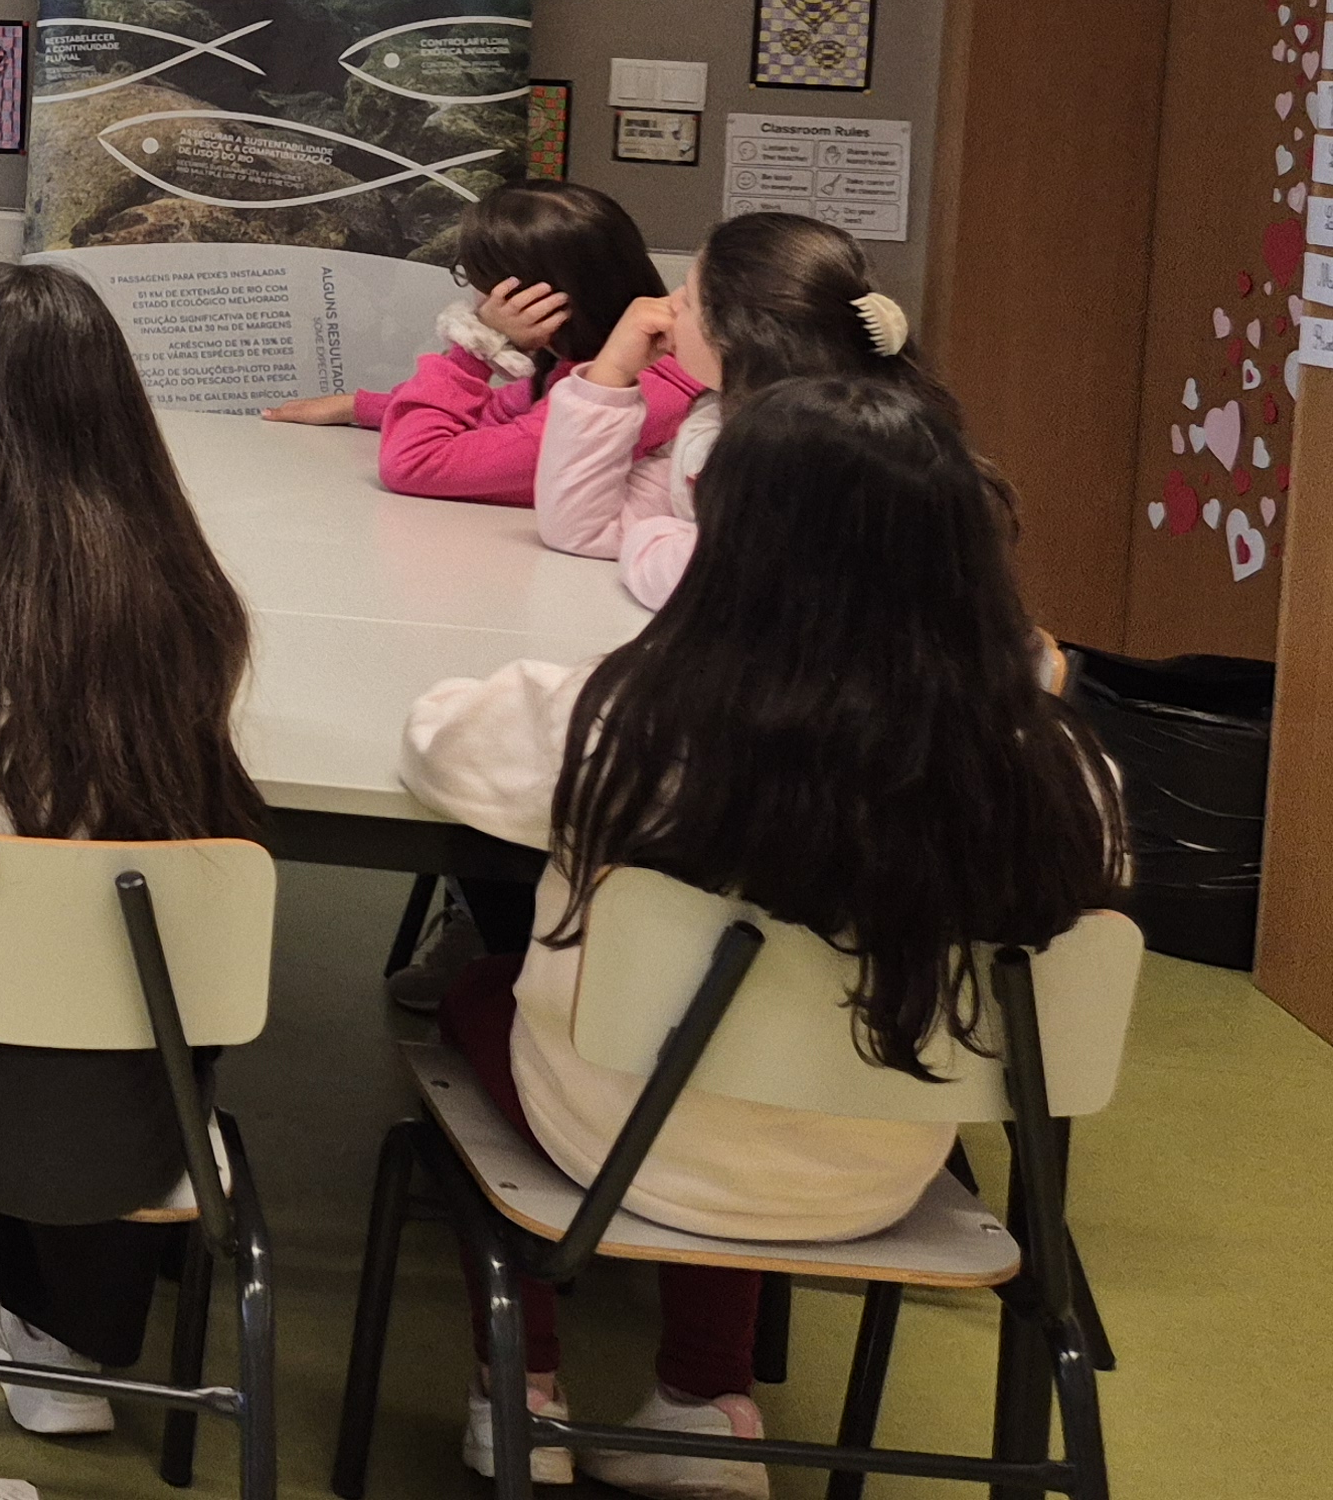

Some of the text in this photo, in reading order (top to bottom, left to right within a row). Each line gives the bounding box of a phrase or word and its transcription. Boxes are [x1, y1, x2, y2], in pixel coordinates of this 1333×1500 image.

[760, 122, 871, 138] Classroom Rules
[117, 273, 171, 284] PASSAGENS
[172, 272, 195, 282] PARA
[196, 270, 229, 280] PEIXES
[230, 267, 286, 279] INSTALADAS
[165, 289, 179, 298] DE
[180, 285, 229, 298] EXTENSÃO
[231, 285, 245, 295] DE
[246, 284, 263, 294] RIO
[264, 284, 289, 294] COM
[132, 294, 289, 310] ESTADO ECOLÓGICO MELHORADO
[133, 310, 291, 327] REDUÇÃO SIGNIFICATIVA DE FLORA
[321, 266, 346, 396] ALGUNS RESULTADO
[204, 392, 248, 402] GALERIAS
